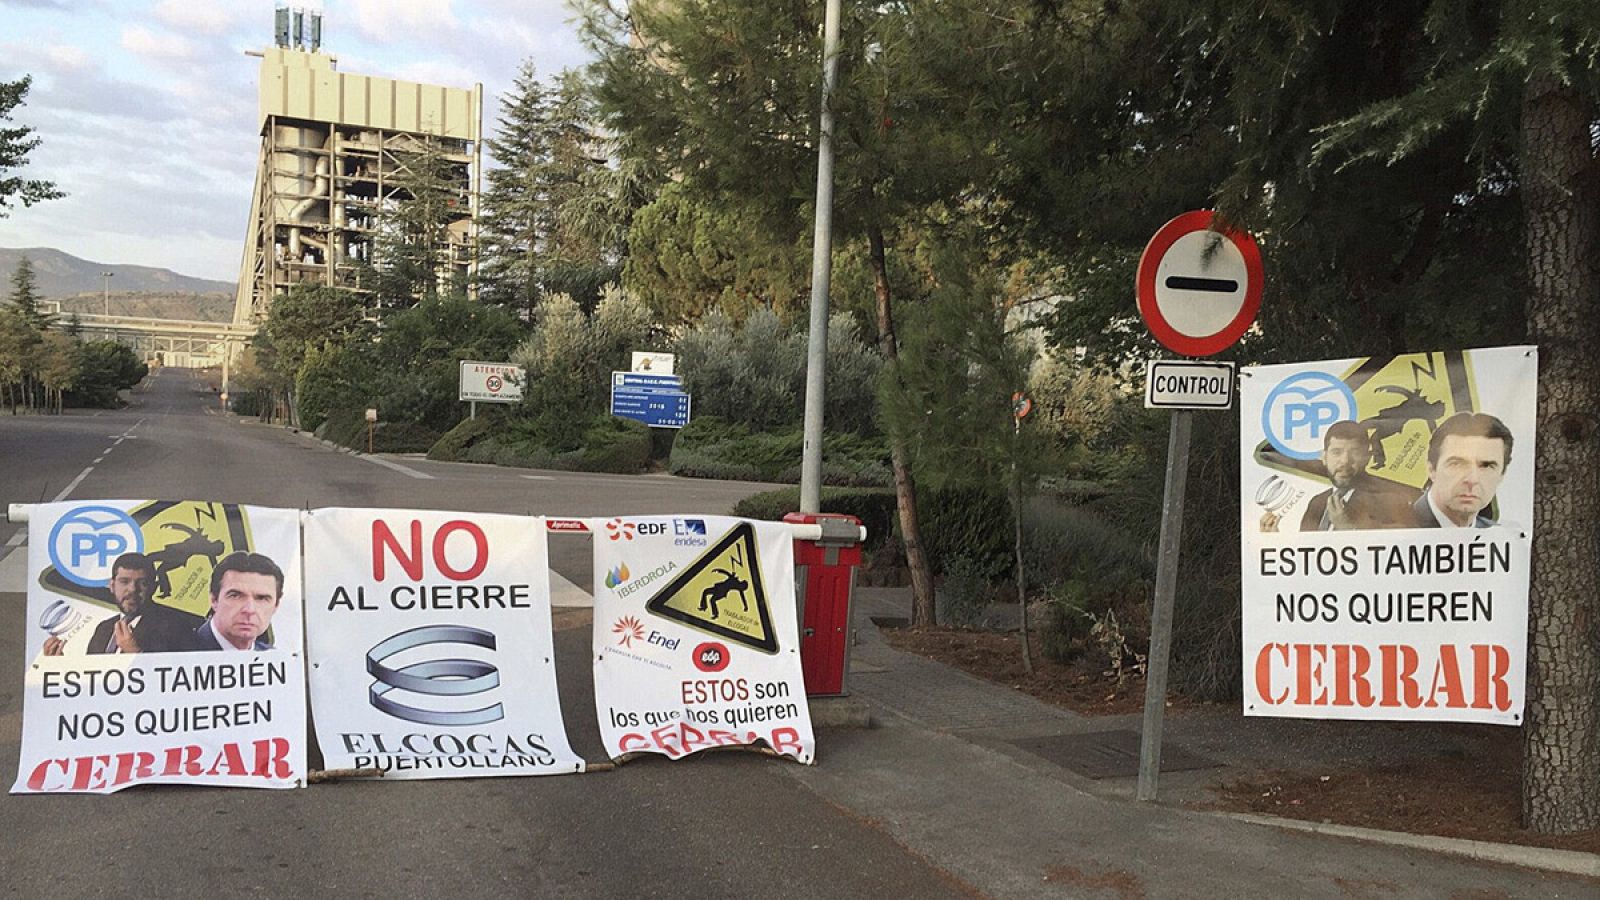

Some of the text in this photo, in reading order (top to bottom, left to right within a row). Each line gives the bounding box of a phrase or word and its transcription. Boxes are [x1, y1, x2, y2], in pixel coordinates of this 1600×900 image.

[1155, 375, 1227, 395] CONTROL
[1283, 401, 1340, 440] PP
[71, 533, 128, 567] PP
[372, 519, 489, 582] NO
[675, 537, 707, 547] endesa
[1261, 536, 1510, 576] ESTOS TAMBIÉN
[617, 560, 677, 599] IBERDROLA
[328, 585, 531, 611] AL CIERRE
[1276, 591, 1493, 624] NOS QUIEREN
[647, 630, 680, 651] Enel
[701, 650, 720, 664] edp
[43, 657, 286, 698] ESTOS TAMBIÉN
[681, 678, 789, 704] ESTOS son
[1255, 642, 1513, 712] CERRAR
[58, 700, 272, 740] NOS QUIEREN
[609, 702, 799, 729] los que nos quieren
[340, 733, 552, 757] ELCOGAS
[26, 737, 294, 791] CERRAR
[355, 755, 556, 773] PUERTOLLANO
